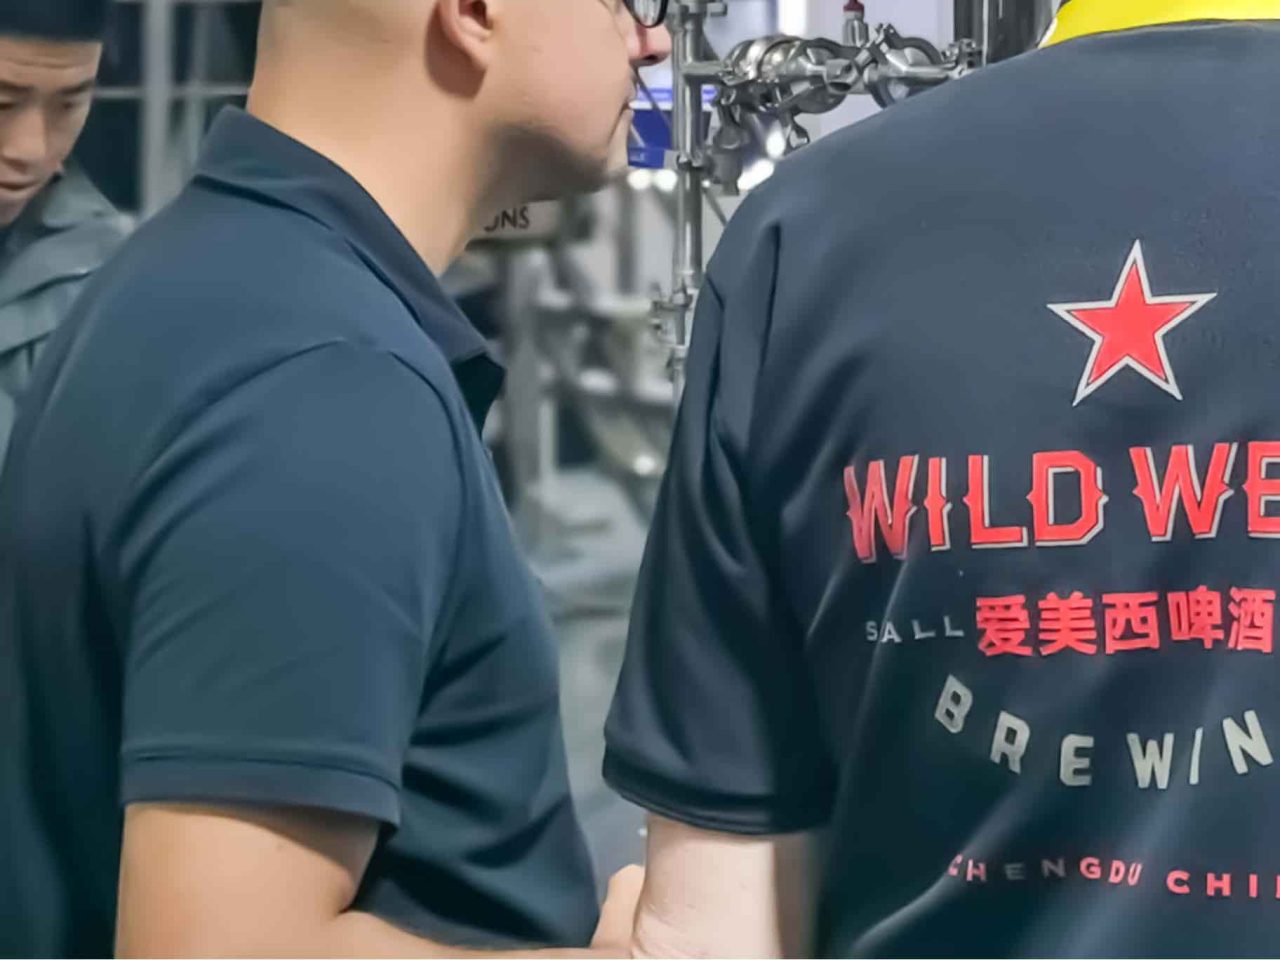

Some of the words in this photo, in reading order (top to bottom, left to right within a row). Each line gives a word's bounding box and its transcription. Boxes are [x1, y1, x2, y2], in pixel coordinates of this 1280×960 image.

[843, 449, 1109, 564] WILD
[975, 584, 1277, 657] 爱美西啤酒
